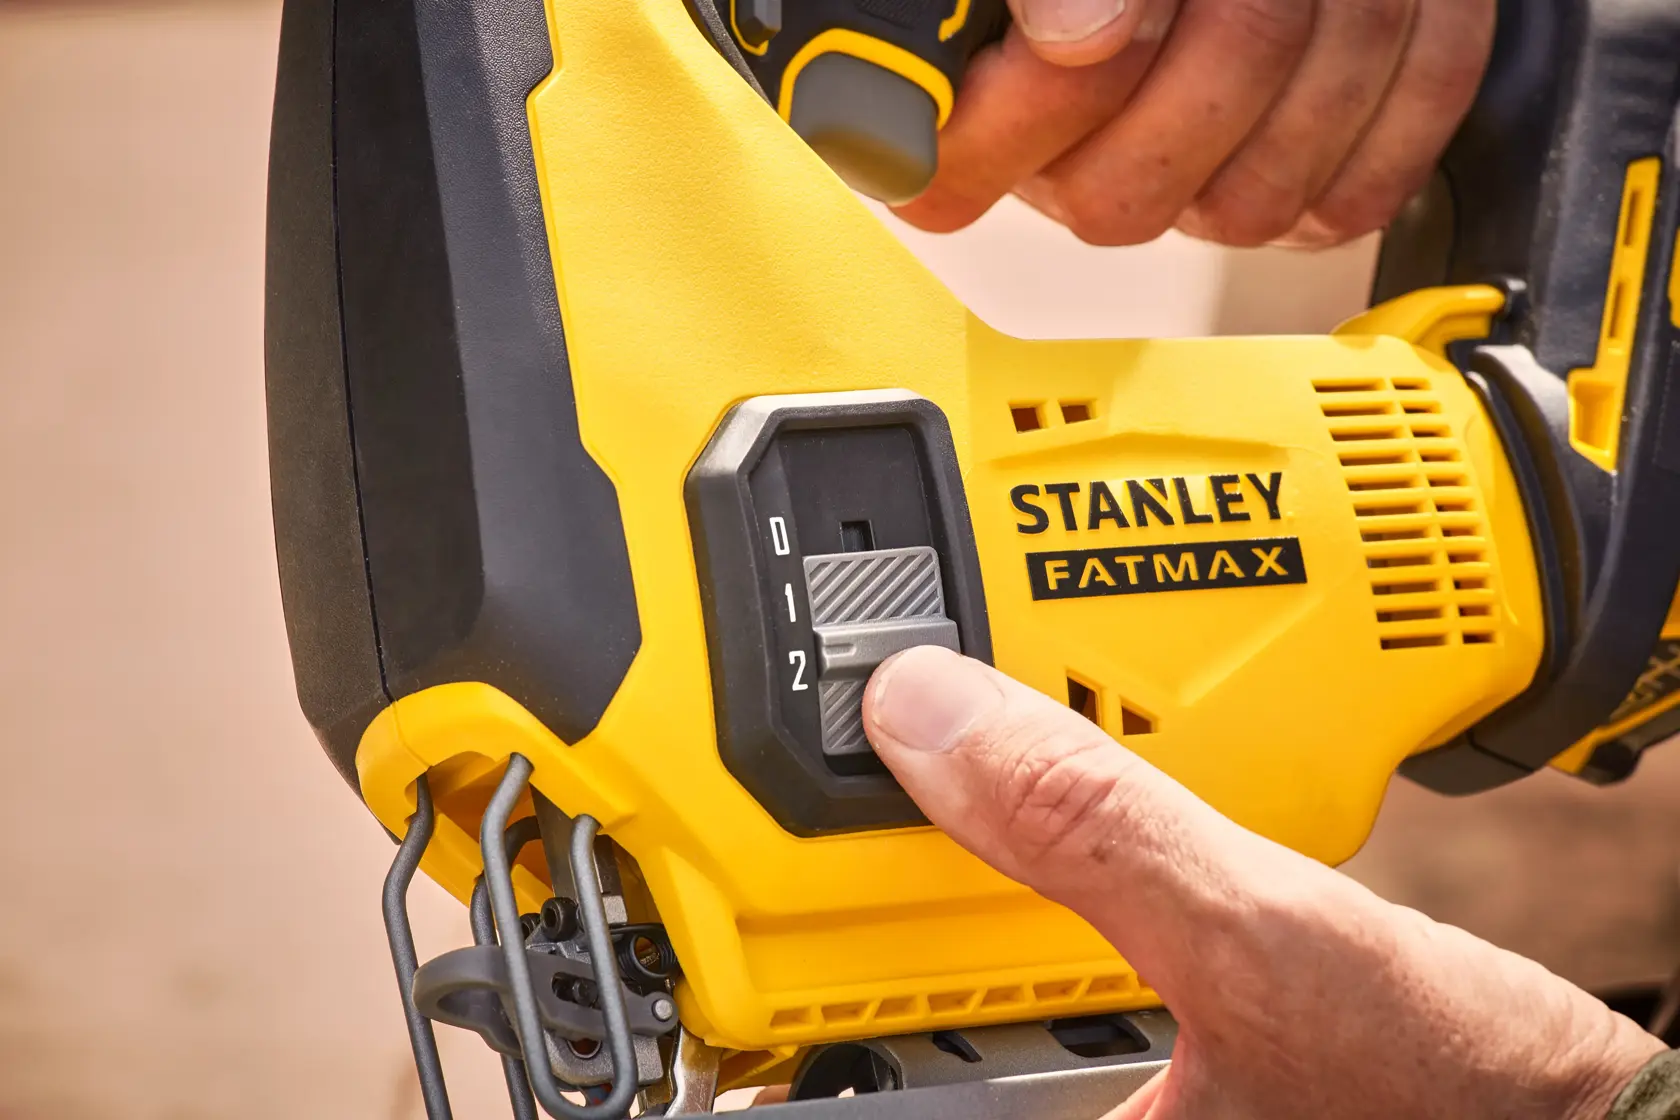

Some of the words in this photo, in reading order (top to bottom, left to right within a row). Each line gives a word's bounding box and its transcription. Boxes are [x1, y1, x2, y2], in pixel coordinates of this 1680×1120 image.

[1009, 472, 1282, 534] STANLEY
[769, 516, 790, 556] 0
[1044, 546, 1288, 590] FATMAX
[784, 583, 796, 623] 1
[788, 650, 808, 691] 2
